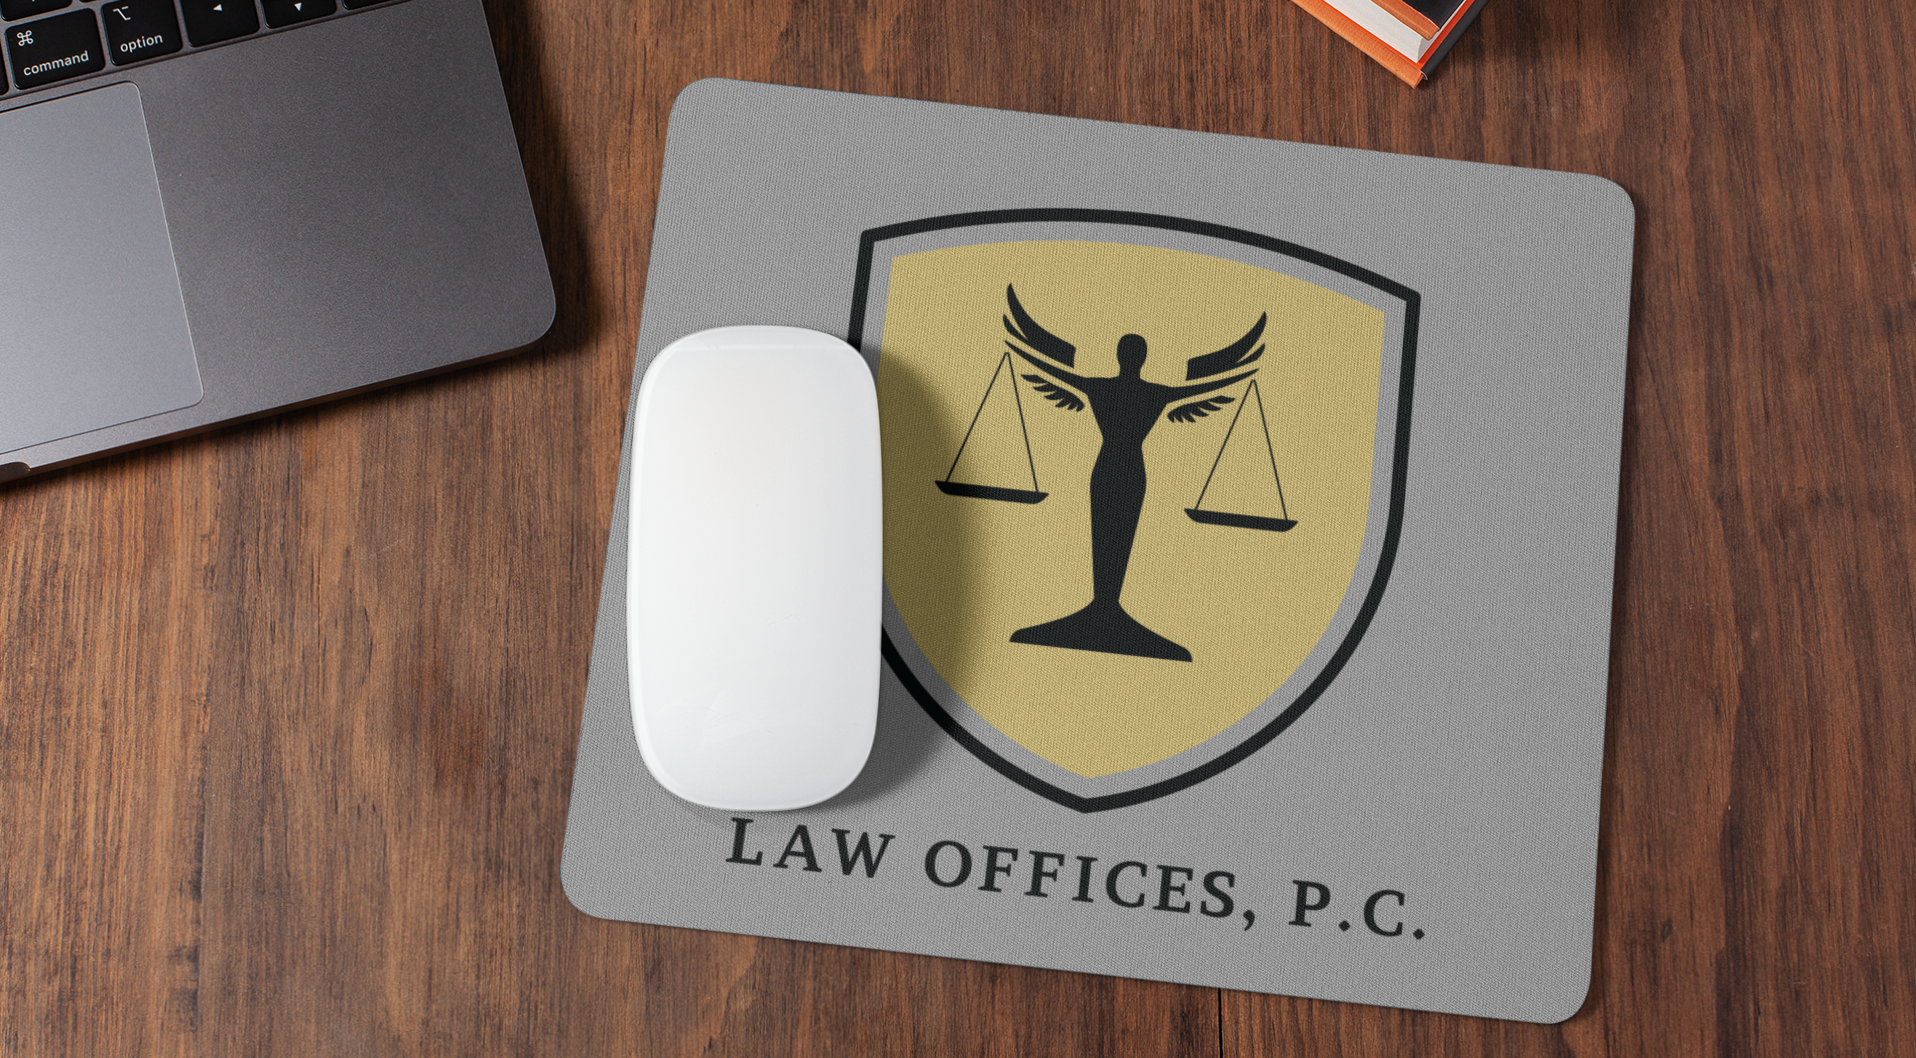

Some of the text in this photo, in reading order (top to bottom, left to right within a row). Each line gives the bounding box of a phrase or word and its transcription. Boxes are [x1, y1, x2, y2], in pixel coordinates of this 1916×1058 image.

[120, 34, 163, 53] option
[23, 50, 90, 76] command
[725, 816, 1427, 941] LAW OFFICES, P.C.
